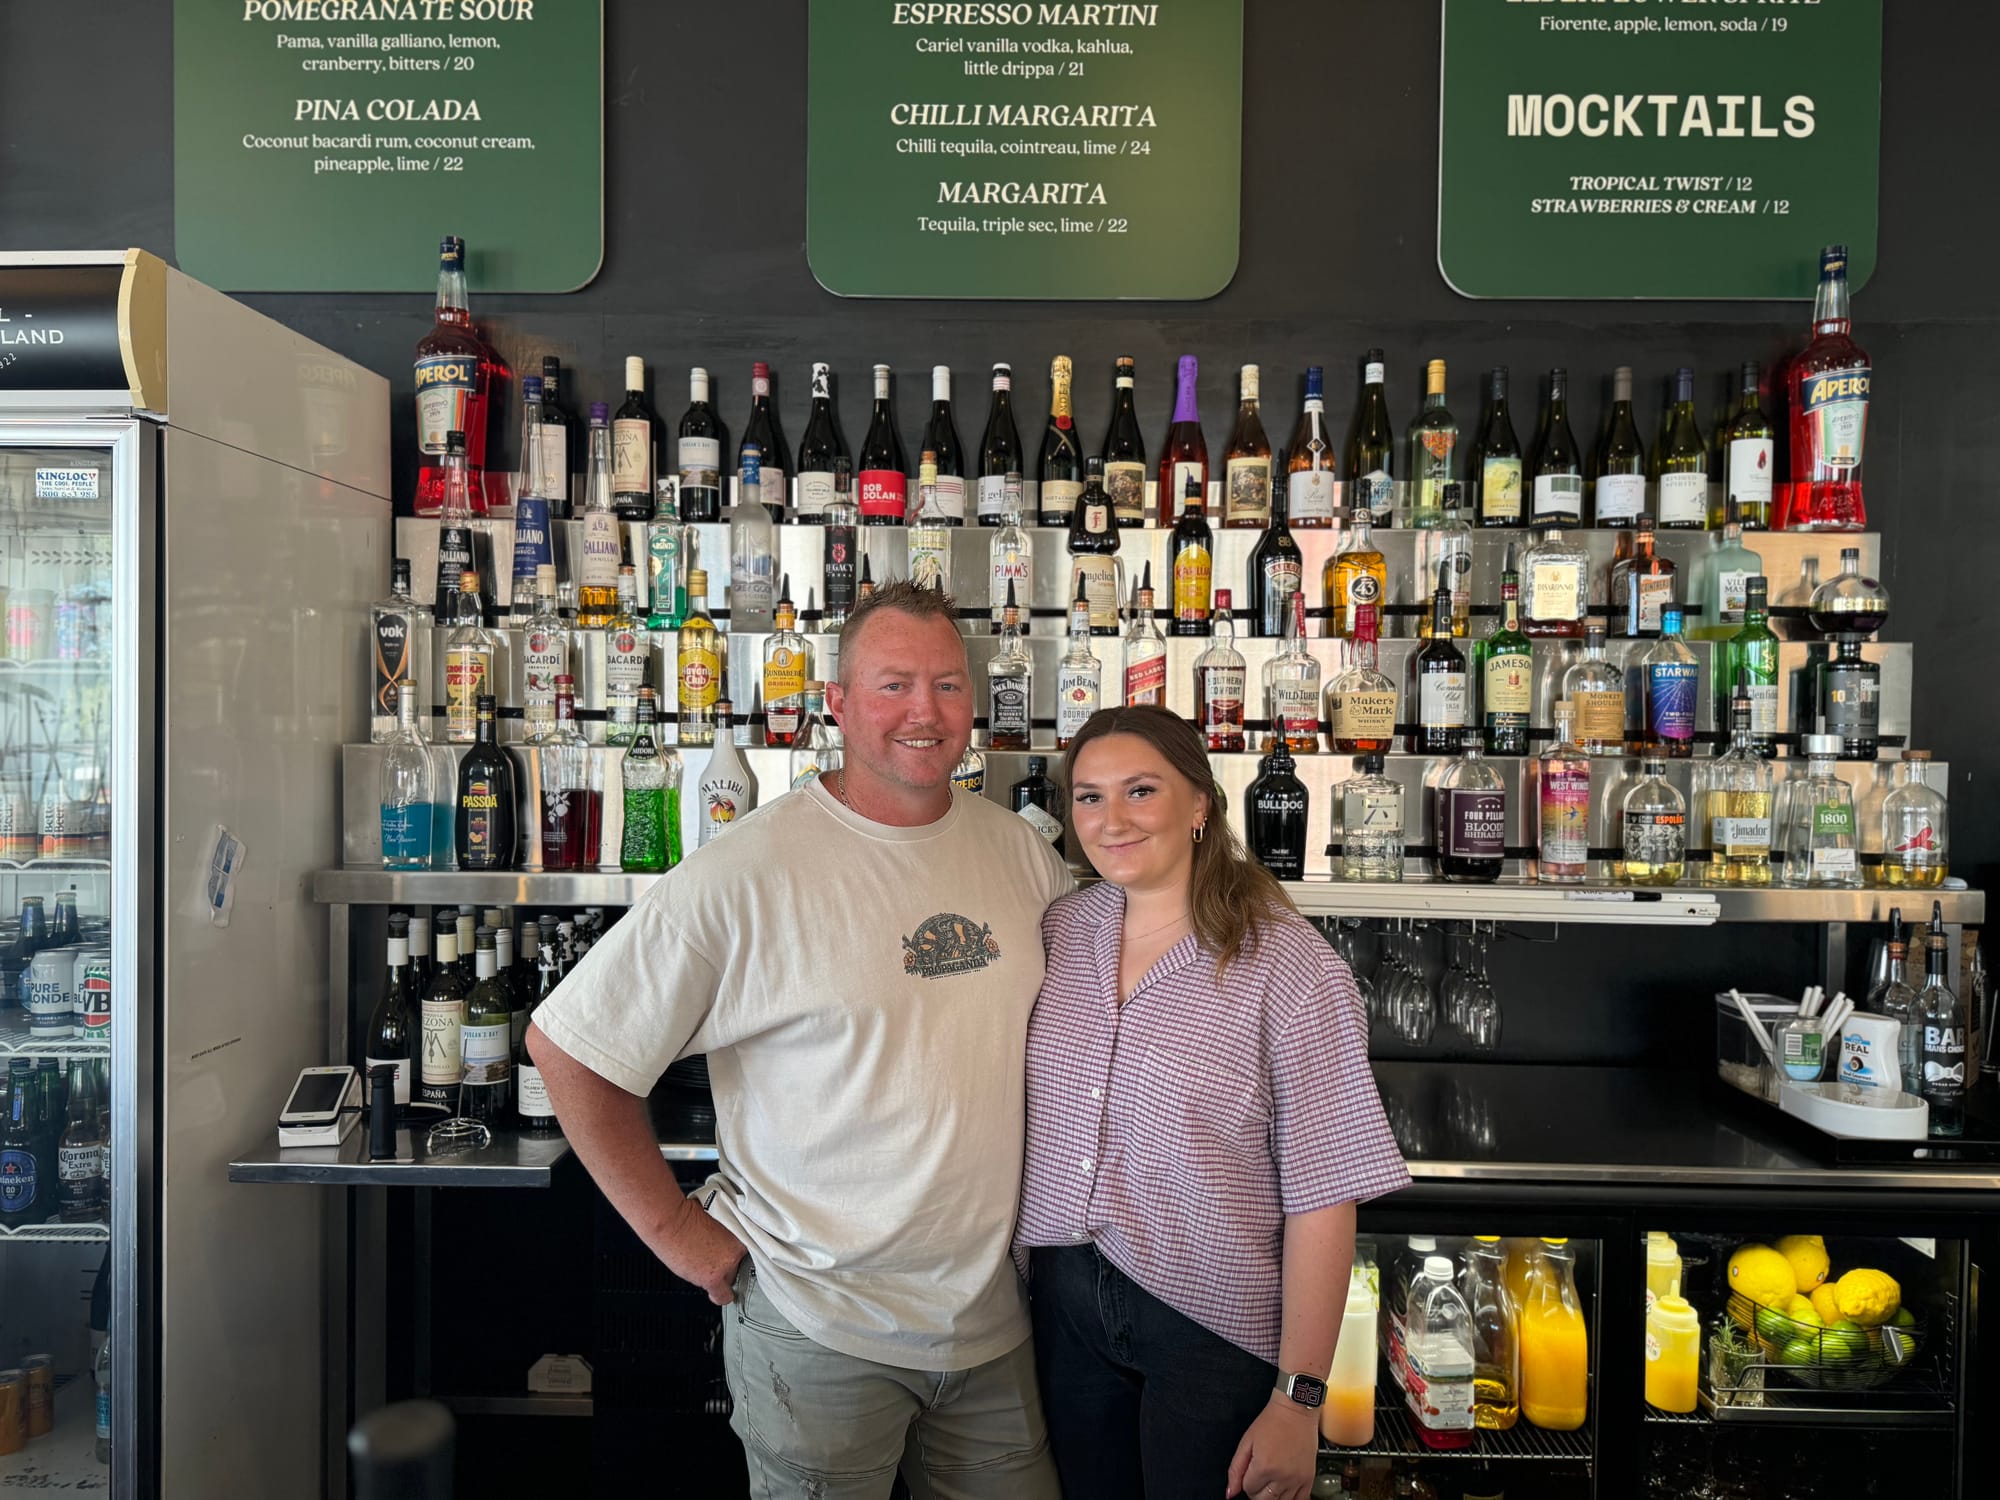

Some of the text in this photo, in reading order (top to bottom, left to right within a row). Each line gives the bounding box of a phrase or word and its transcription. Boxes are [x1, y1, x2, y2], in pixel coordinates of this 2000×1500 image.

[243, 0, 534, 21] POMEGRANATE SOUR
[892, 2, 1159, 26] ESPRESSO MARTINI
[1540, 15, 1788, 35] Fiorente, apple, lemon, soda / 19
[277, 33, 501, 52] Pama, vanilla galliano, lemon,
[915, 37, 1134, 55] Cariel vanilla vodka, kahlua,
[302, 55, 475, 76] cranberry, bitters / 20
[964, 60, 1084, 80] little drippa / 21
[294, 99, 482, 121] PINA COLADA
[890, 103, 1157, 127] CHILLI MARGARITA
[1507, 93, 1815, 139] MOCKTAILS
[242, 133, 535, 150] Coconut bacardi rum, coconut cream,
[896, 138, 1151, 157] Chilli tequila, cointreau, lime / 24
[314, 155, 464, 175] pineapple, lime / 22
[1569, 176, 1753, 191] TROPICAL TWIST / 12
[937, 181, 1108, 205] MARGARITA
[1530, 198, 1790, 214] STRAWBERRIES & CREAM / 12
[917, 216, 1128, 236] Tequila, triple sec, lime / 22
[1, 329, 64, 344] LAND
[863, 484, 881, 492] ROB
[863, 491, 896, 500] DOLAN
[825, 563, 854, 573] LEGACY
[994, 562, 1029, 578] PIMM'S
[1355, 581, 1374, 596] 43
[686, 674, 707, 684] Club
[1129, 672, 1145, 682] RED
[1144, 665, 1165, 678] LABEL
[1060, 675, 1099, 692] JIM BEAM
[1278, 689, 1300, 700] WILD
[1350, 696, 1394, 705] Maker's
[1831, 689, 1846, 703] 10
[1361, 706, 1393, 715] Mark
[702, 780, 745, 796] MALIBU
[1550, 781, 1570, 790] WEST
[1257, 800, 1303, 809] BULLDOG
[1464, 811, 1484, 820] FOUR
[1819, 813, 1848, 824] 1800
[1732, 823, 1768, 839] Jimador
[921, 957, 986, 977] PROPAGANDA
[84, 991, 110, 1013] VB
[1844, 1042, 1869, 1054] REAL
[60, 1150, 99, 1162] Corona
[68, 1160, 92, 1169] Extra
[1306, 1385, 1322, 1406] 10
